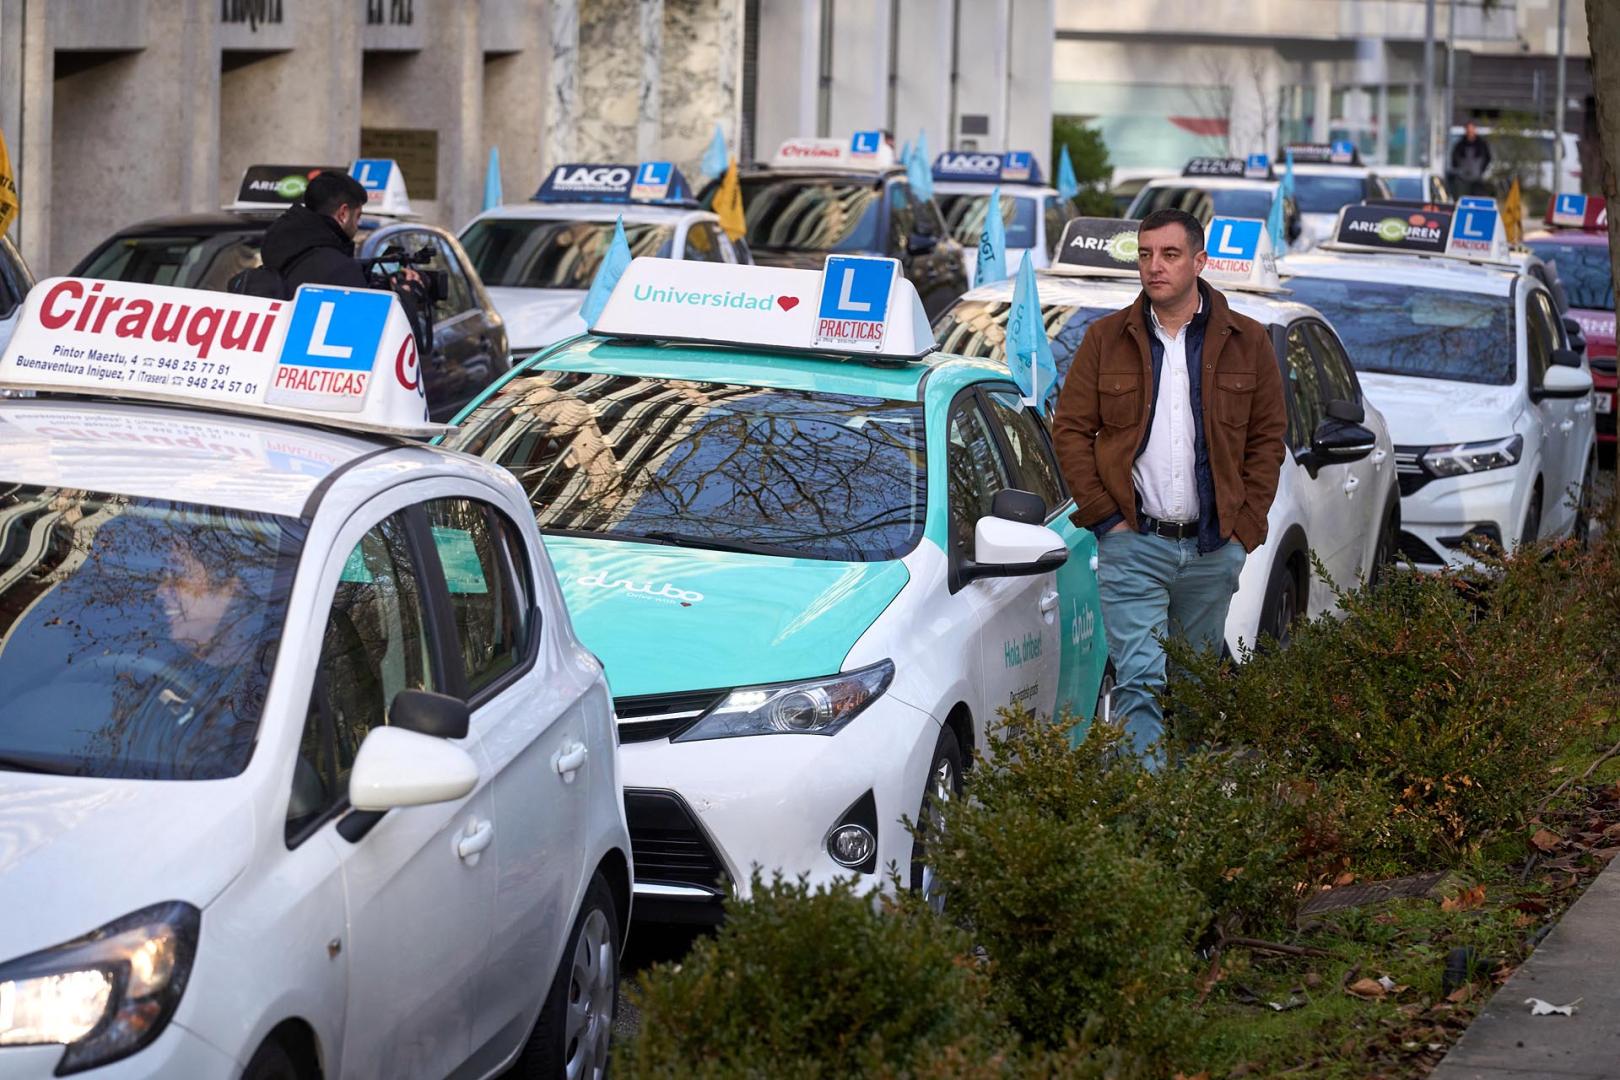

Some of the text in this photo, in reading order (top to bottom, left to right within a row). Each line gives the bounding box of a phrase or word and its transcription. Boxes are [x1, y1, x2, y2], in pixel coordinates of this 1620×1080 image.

[857, 134, 873, 151] L
[643, 164, 661, 183] L
[941, 155, 1000, 171] LAGO
[1010, 153, 1024, 168] L
[360, 164, 379, 187] L
[553, 167, 631, 186] LAGO
[1562, 195, 1577, 212] L
[1349, 220, 1441, 239] ARIZCUREN
[1463, 213, 1483, 236] L
[980, 231, 996, 262] DGT
[1218, 224, 1243, 255] L
[634, 284, 774, 311] Universidad
[838, 268, 871, 312] L
[39, 280, 282, 359] Cirauqui
[306, 301, 353, 359] L
[819, 319, 883, 340] PRACTICAS
[53, 344, 230, 375] Pintor Maeztu, 4 948 25 77 81
[16, 355, 84, 375] Buenaventura
[128, 370, 136, 381] 7
[186, 376, 207, 389] 948
[211, 379, 225, 390] 24
[228, 381, 242, 393] 57
[245, 383, 259, 395] 01
[275, 366, 366, 395] PRACTICAS
[576, 570, 704, 602] dribo
[1004, 638, 1023, 668] Hola,
